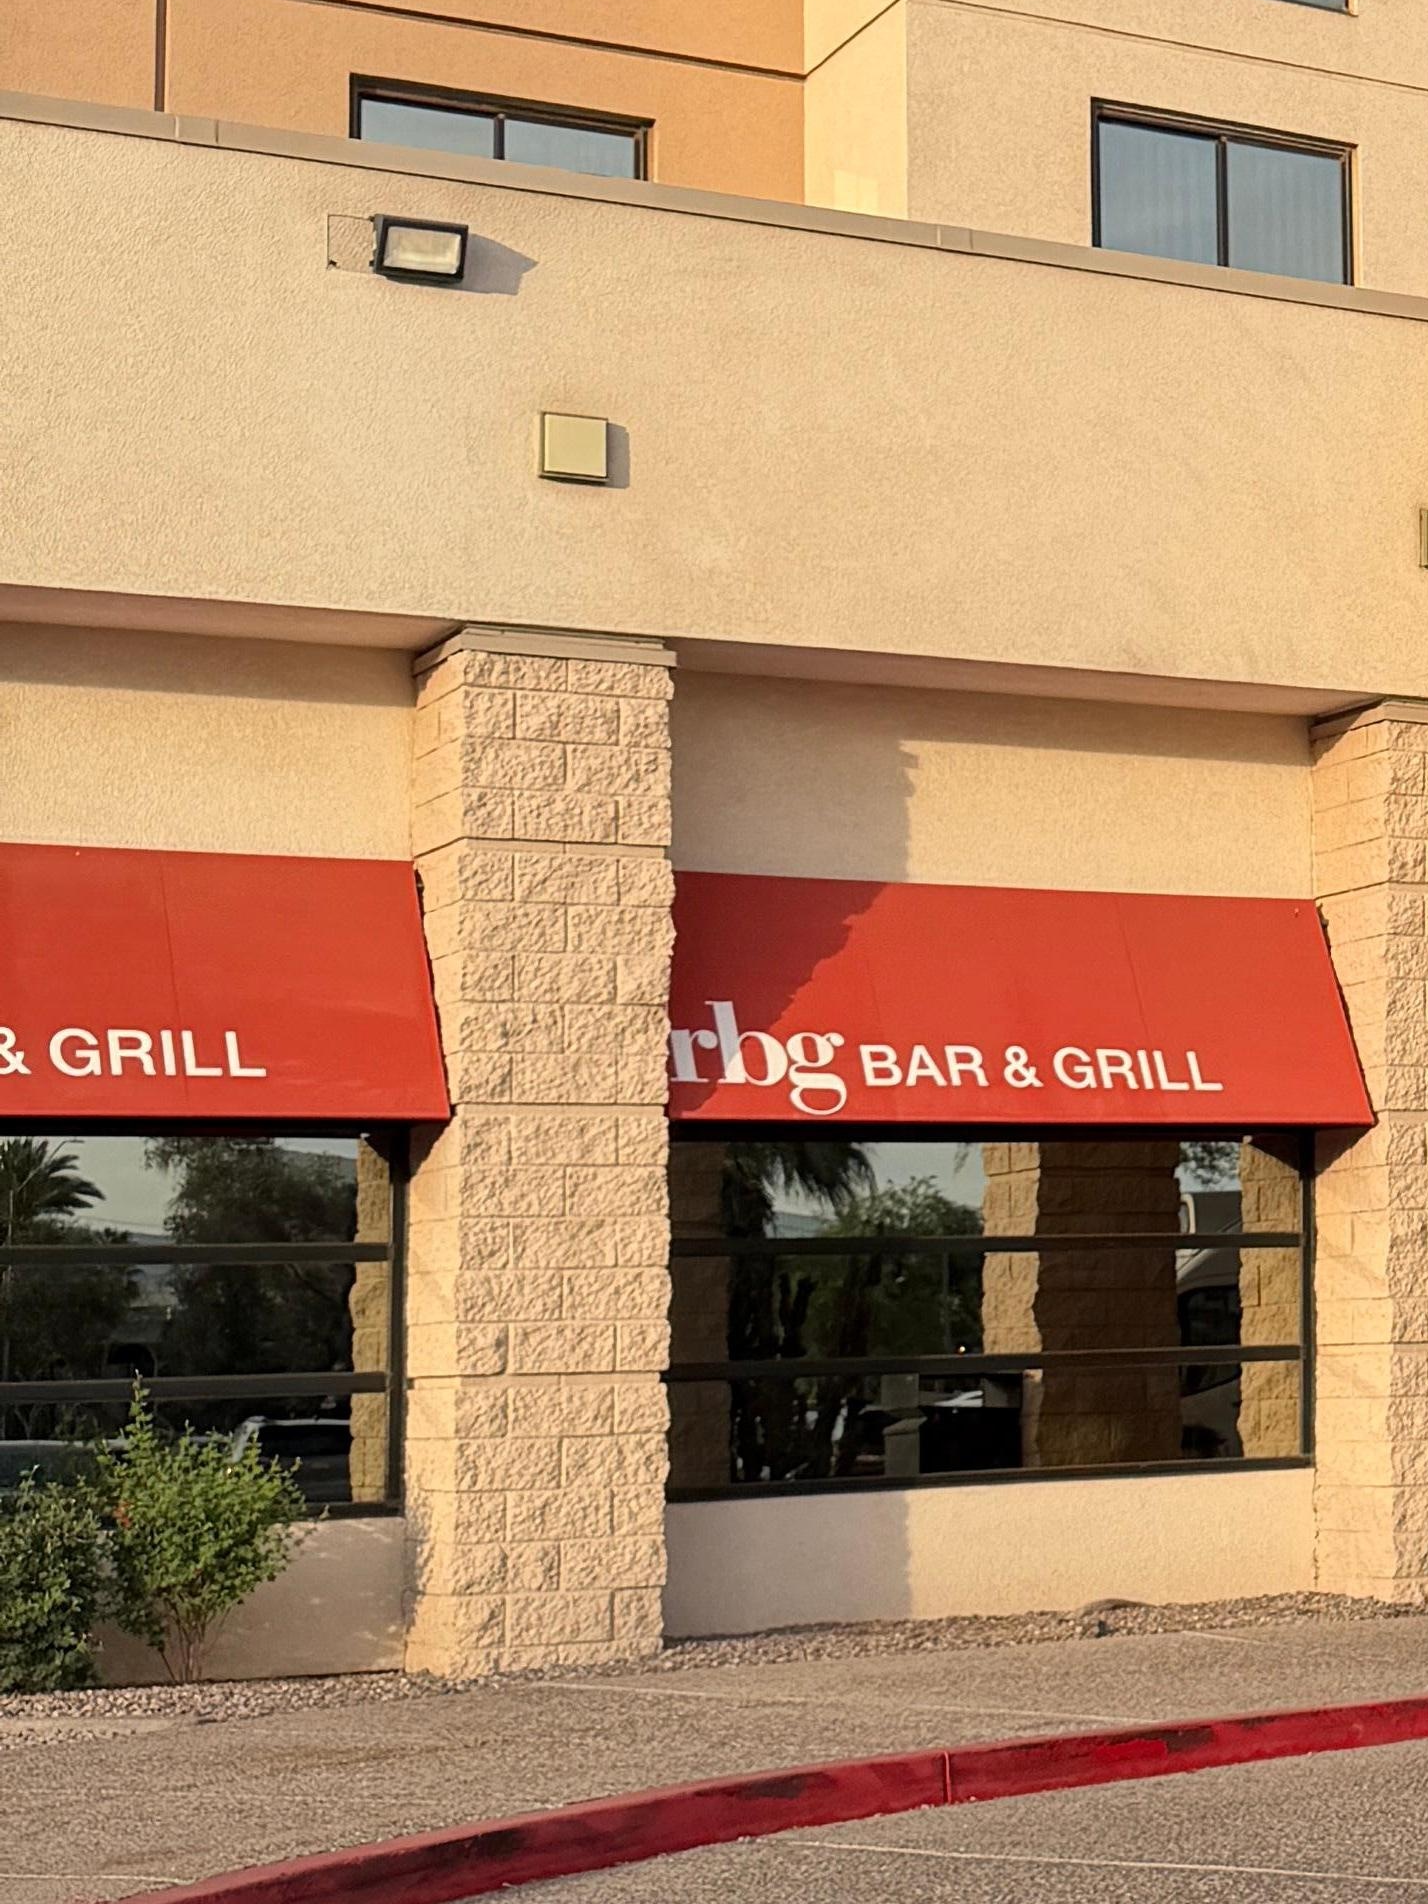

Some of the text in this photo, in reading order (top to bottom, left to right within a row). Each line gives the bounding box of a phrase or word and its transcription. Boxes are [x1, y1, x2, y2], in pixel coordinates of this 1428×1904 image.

[49, 1027, 267, 1077] GRILL
[671, 1001, 1224, 1116] rbg BAR & GRILL
